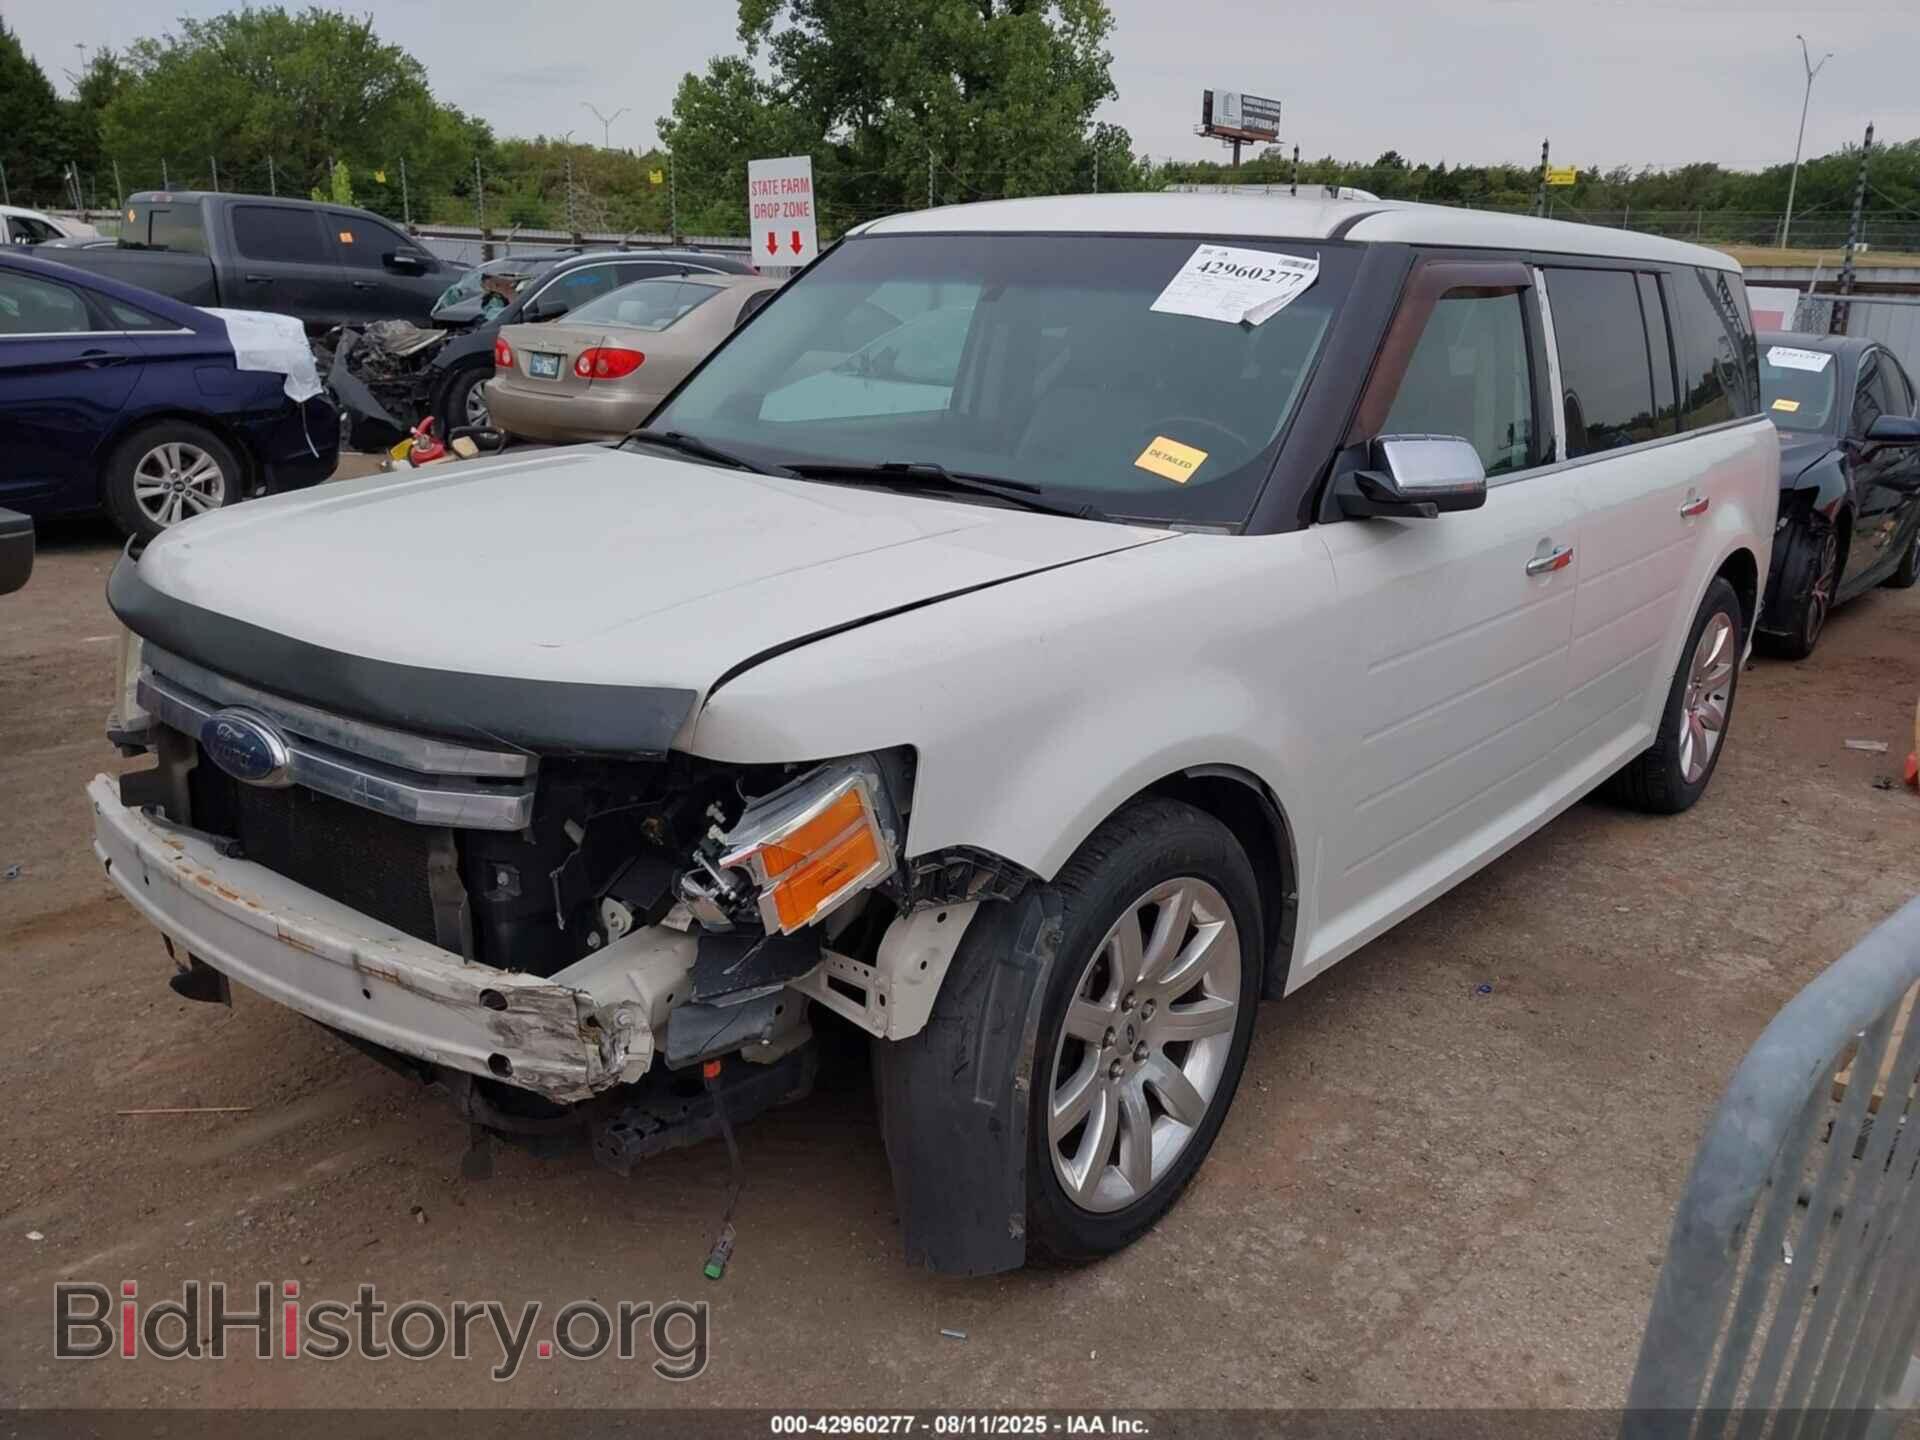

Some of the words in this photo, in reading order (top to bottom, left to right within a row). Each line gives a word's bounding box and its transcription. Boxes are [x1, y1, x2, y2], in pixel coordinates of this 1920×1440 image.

[751, 179, 779, 196] STATE
[781, 177, 811, 194] FARM
[753, 202, 780, 219] DROP
[783, 201, 810, 218] ZONE
[1196, 259, 1304, 287] 42960277
[1148, 448, 1193, 469] DETAILED
